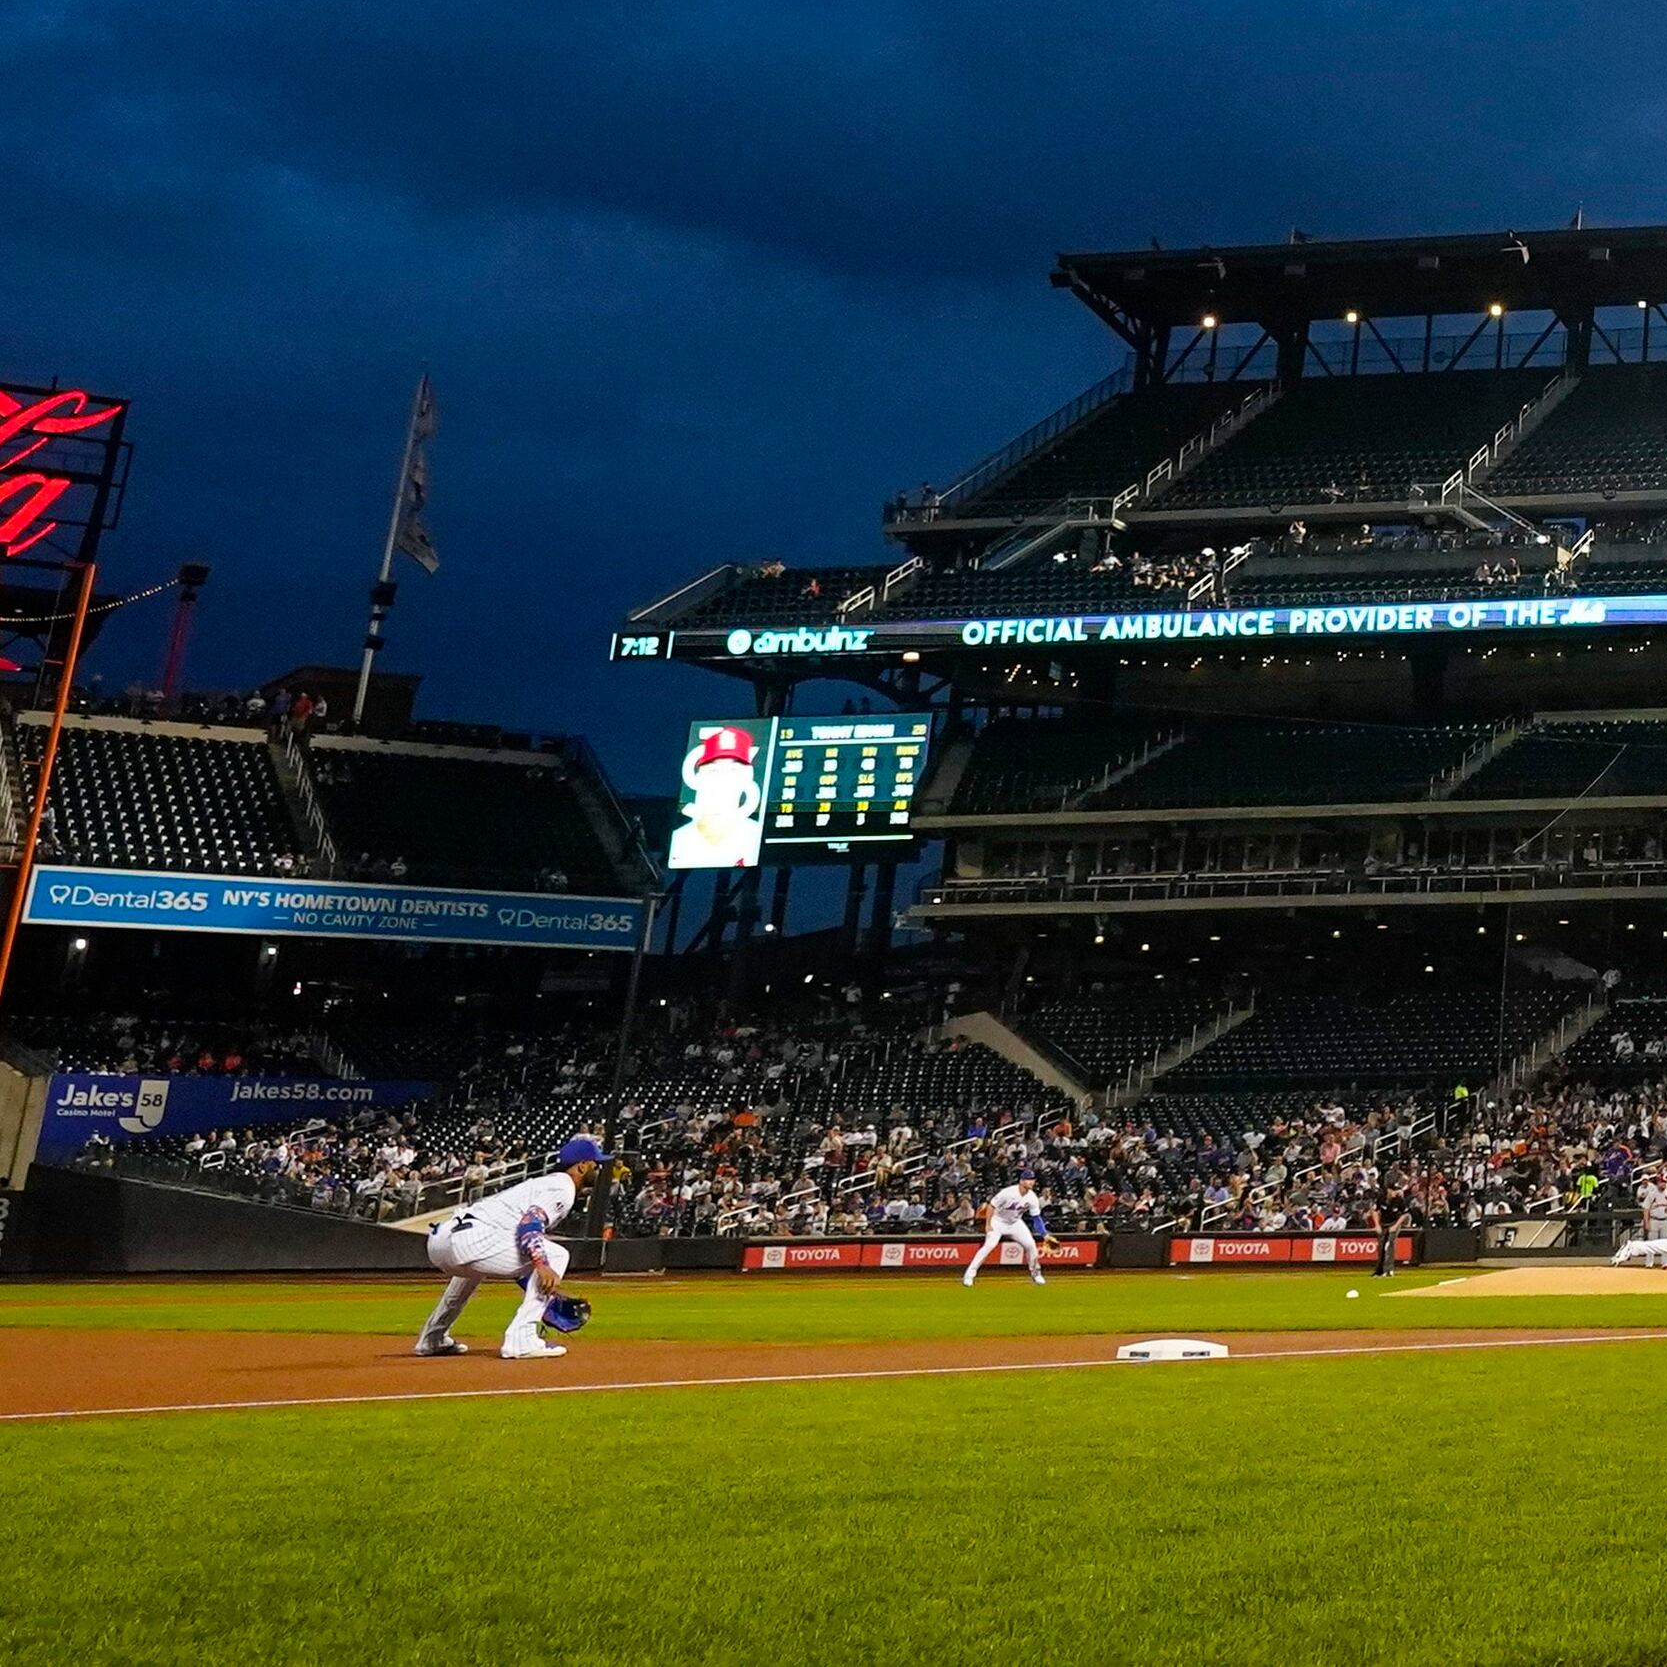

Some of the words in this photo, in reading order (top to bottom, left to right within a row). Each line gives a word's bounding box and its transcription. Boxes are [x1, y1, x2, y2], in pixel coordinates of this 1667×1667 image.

[962, 617, 1088, 646] OFFICIAL
[1099, 610, 1275, 640] AMBULANCE
[1289, 605, 1433, 633] PROVIDER
[1448, 602, 1488, 628] OF
[1504, 600, 1555, 626] THE
[621, 636, 659, 657] 7:12
[753, 625, 868, 655] ambulnz
[71, 885, 208, 911] Dental365
[222, 890, 271, 908] NY'S
[274, 892, 397, 914] HOMETOWN
[401, 898, 489, 918] DENTISTS
[293, 913, 318, 925] NO
[322, 914, 376, 928] CAVITY
[377, 916, 418, 930] ZONE
[516, 909, 633, 933] Dental365
[57, 1084, 134, 1108] Jake's
[140, 1094, 163, 1107] 58
[230, 1082, 374, 1103] jakes58.com
[57, 1108, 88, 1117] Casino
[90, 1109, 116, 1117] Hotel
[790, 1247, 840, 1262] TOYOTA
[909, 1246, 960, 1261] TOYOTA
[1218, 1241, 1270, 1256] TOYOTA
[1340, 1240, 1378, 1255] TOYO
